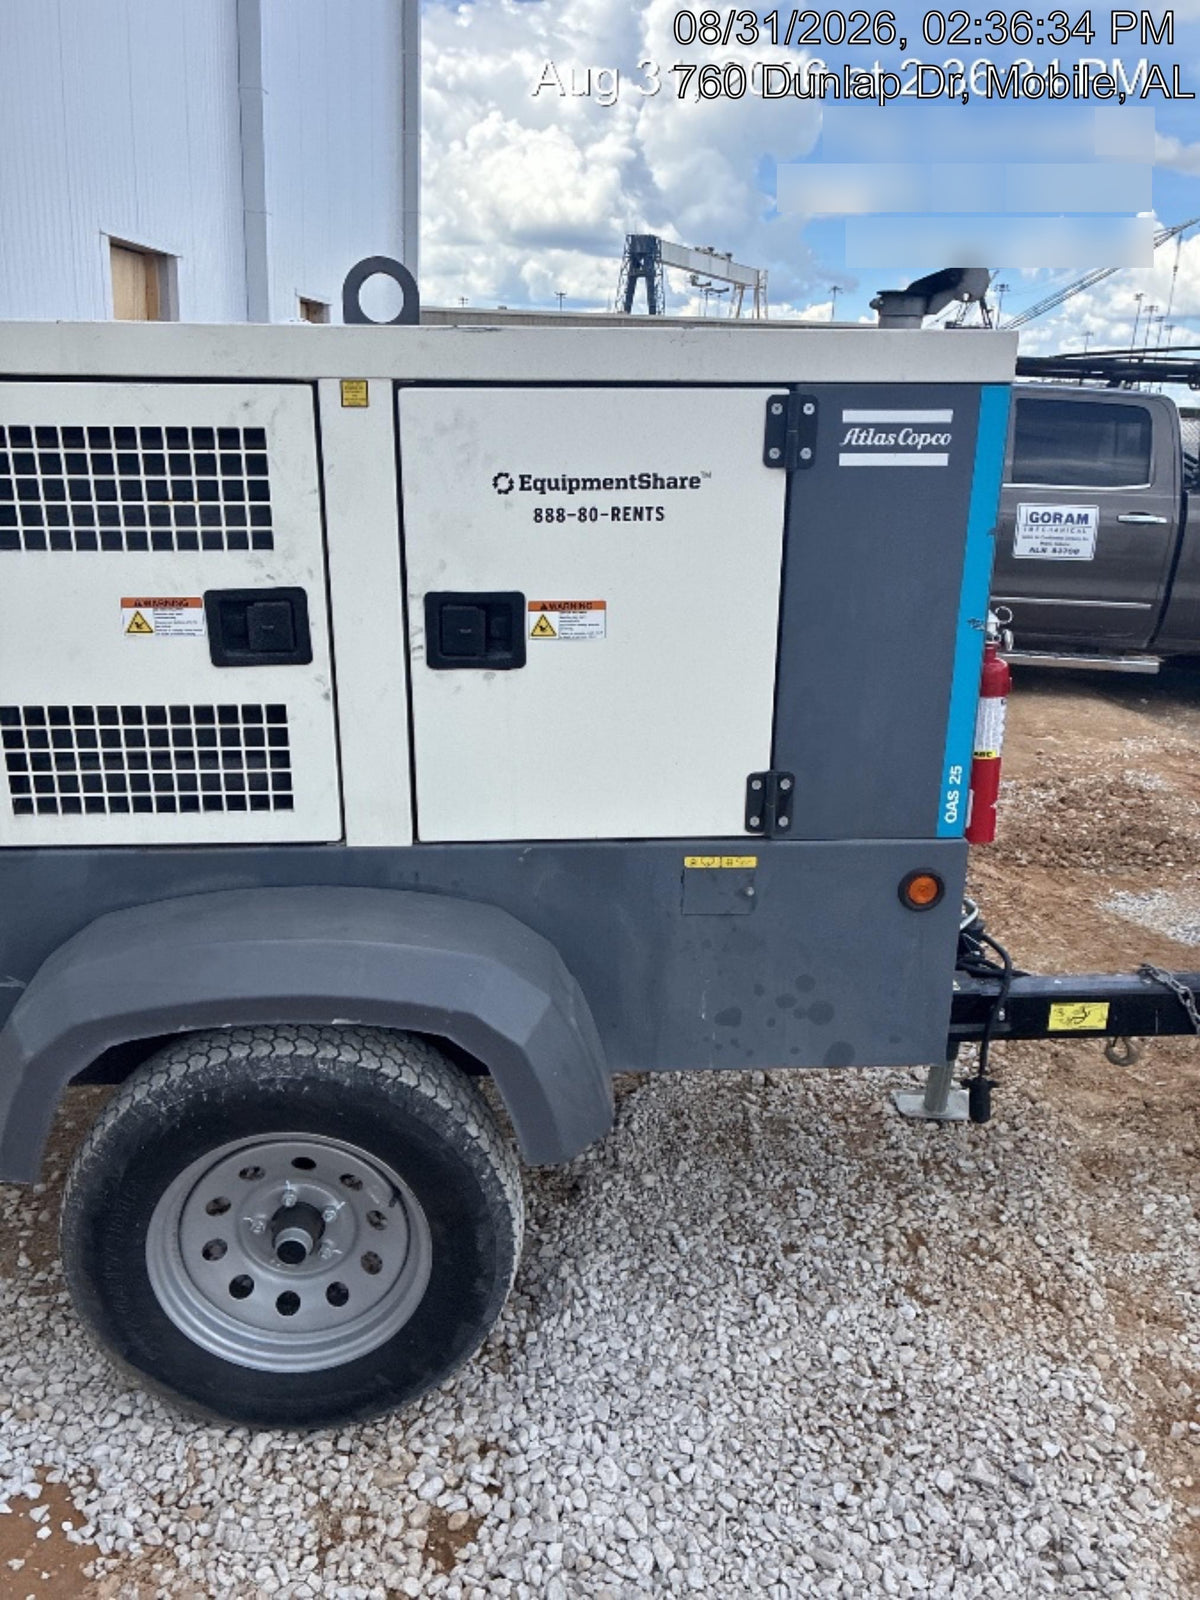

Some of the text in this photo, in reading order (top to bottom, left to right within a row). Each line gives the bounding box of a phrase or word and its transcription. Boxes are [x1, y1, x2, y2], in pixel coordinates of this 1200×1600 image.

[839, 427, 952, 450] Atlas Copco
[518, 472, 702, 495] EquipmentShare
[533, 506, 665, 524] 888-80-RENTS
[1028, 511, 1090, 525] GORAM
[949, 765, 963, 784] 25
